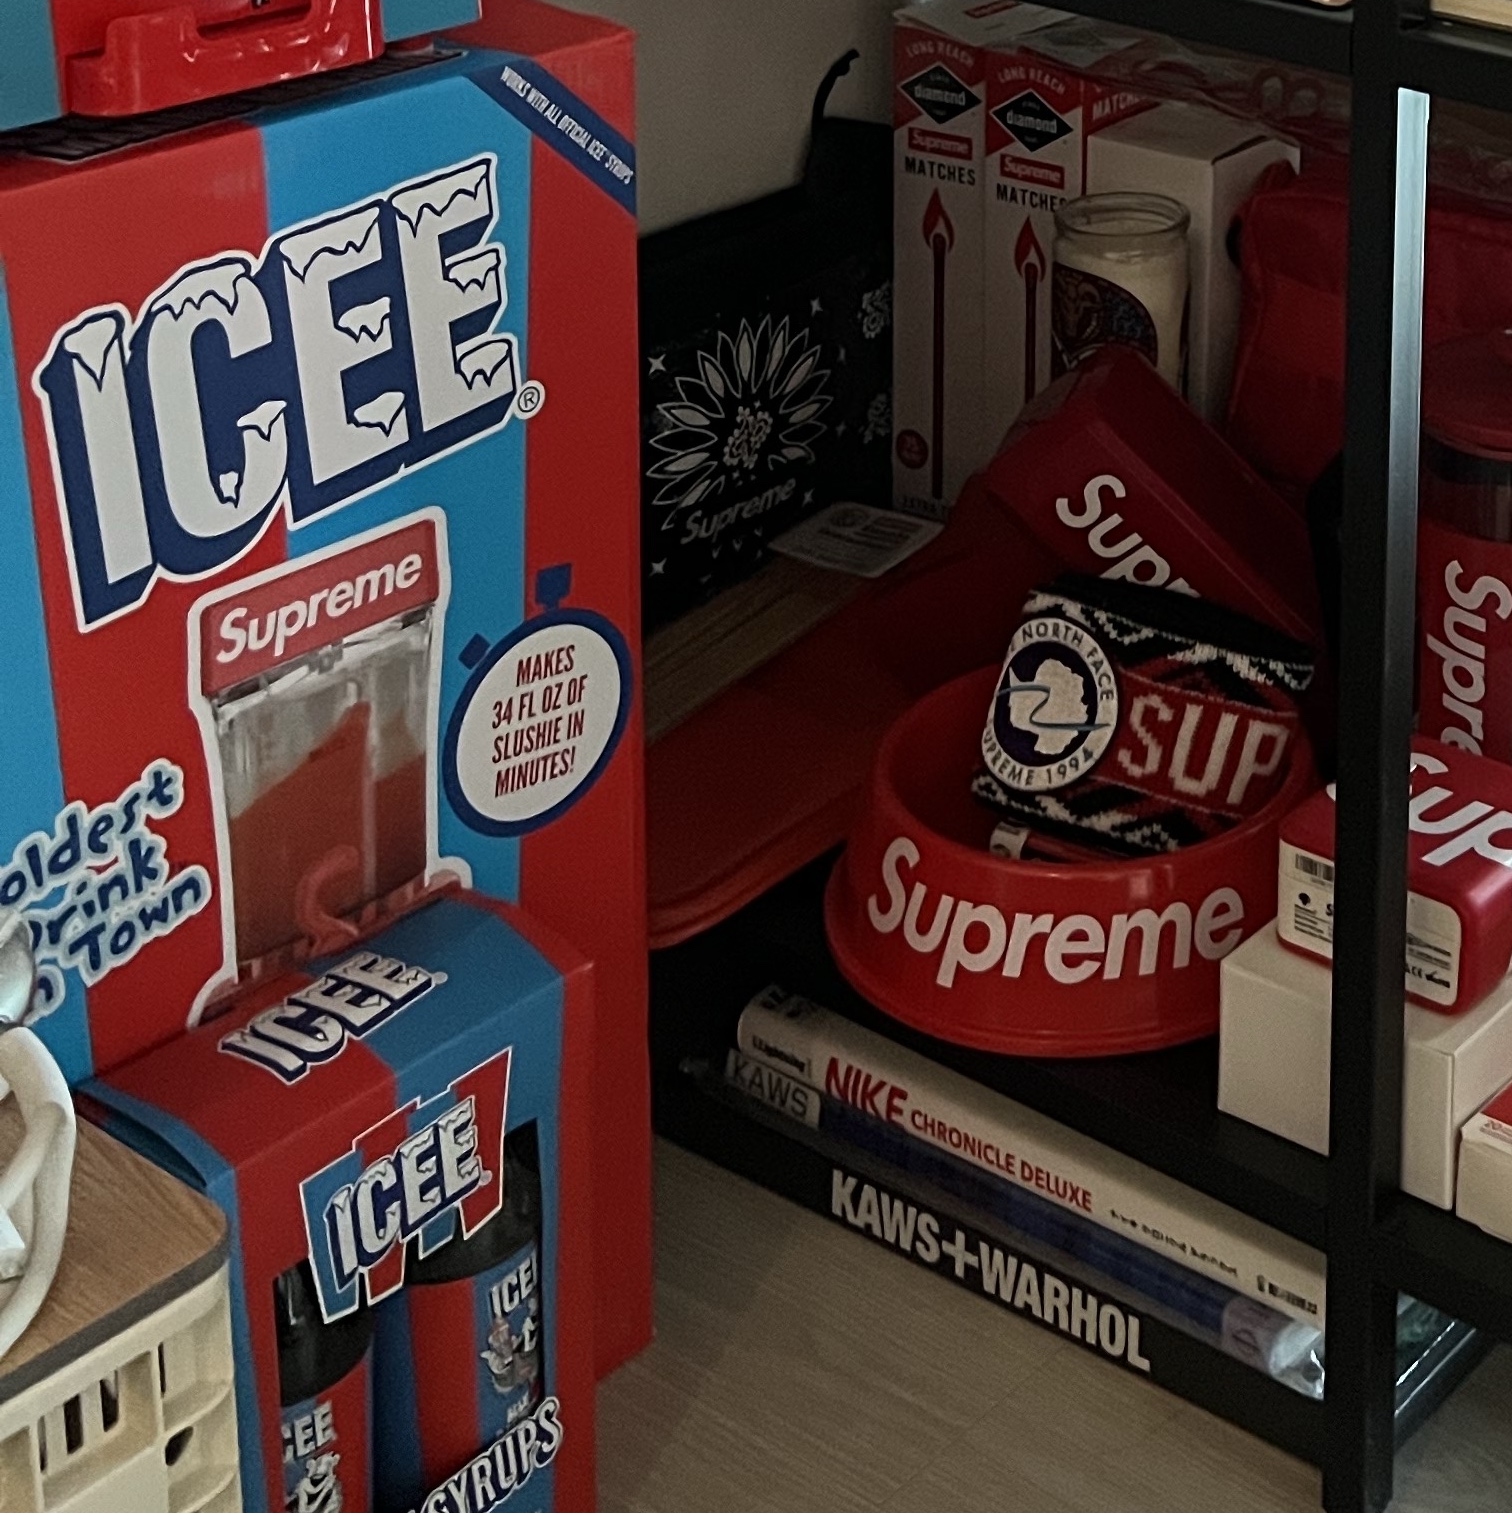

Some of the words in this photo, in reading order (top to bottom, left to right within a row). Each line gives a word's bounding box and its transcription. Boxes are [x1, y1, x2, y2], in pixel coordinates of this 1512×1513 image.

[906, 42, 934, 59] LONG
[937, 41, 976, 69] REACH
[998, 67, 1026, 85] LONG
[1028, 68, 1067, 94] REACH
[913, 84, 967, 107] diamond
[1006, 109, 1059, 134] diamond
[544, 103, 562, 125] ALL
[586, 139, 610, 162] ICEE
[911, 130, 970, 155] Supreme
[905, 155, 977, 187] MATCHES
[1004, 156, 1062, 184] Supreme
[36, 156, 519, 631] ICEE
[680, 476, 798, 545] Supreme
[217, 552, 423, 664] Supreme
[517, 644, 576, 687] MAKES
[1021, 618, 1085, 657] NORTH
[1086, 644, 1118, 704] FACE
[491, 700, 515, 730] 34
[518, 694, 538, 722] FL
[541, 686, 564, 715] OZ
[566, 677, 587, 707] OF
[491, 722, 564, 766] SLUSHIE
[565, 709, 585, 742] IN
[1045, 746, 1097, 787] 1994
[1117, 691, 1291, 808] SUP
[494, 750, 577, 799] MINUTES!
[68, 874, 204, 972] Town
[867, 835, 1246, 989] Supreme
[218, 950, 436, 1086] ICEE
[726, 1048, 812, 1122] KAWS
[825, 1056, 909, 1125] NIKE
[910, 1108, 1017, 1177] CHRONICLE
[1019, 1157, 1093, 1213] DELUXE
[322, 1094, 482, 1292] ICEE
[489, 1249, 538, 1318] ICE
[830, 1168, 1152, 1374] KAWS+WARHOL
